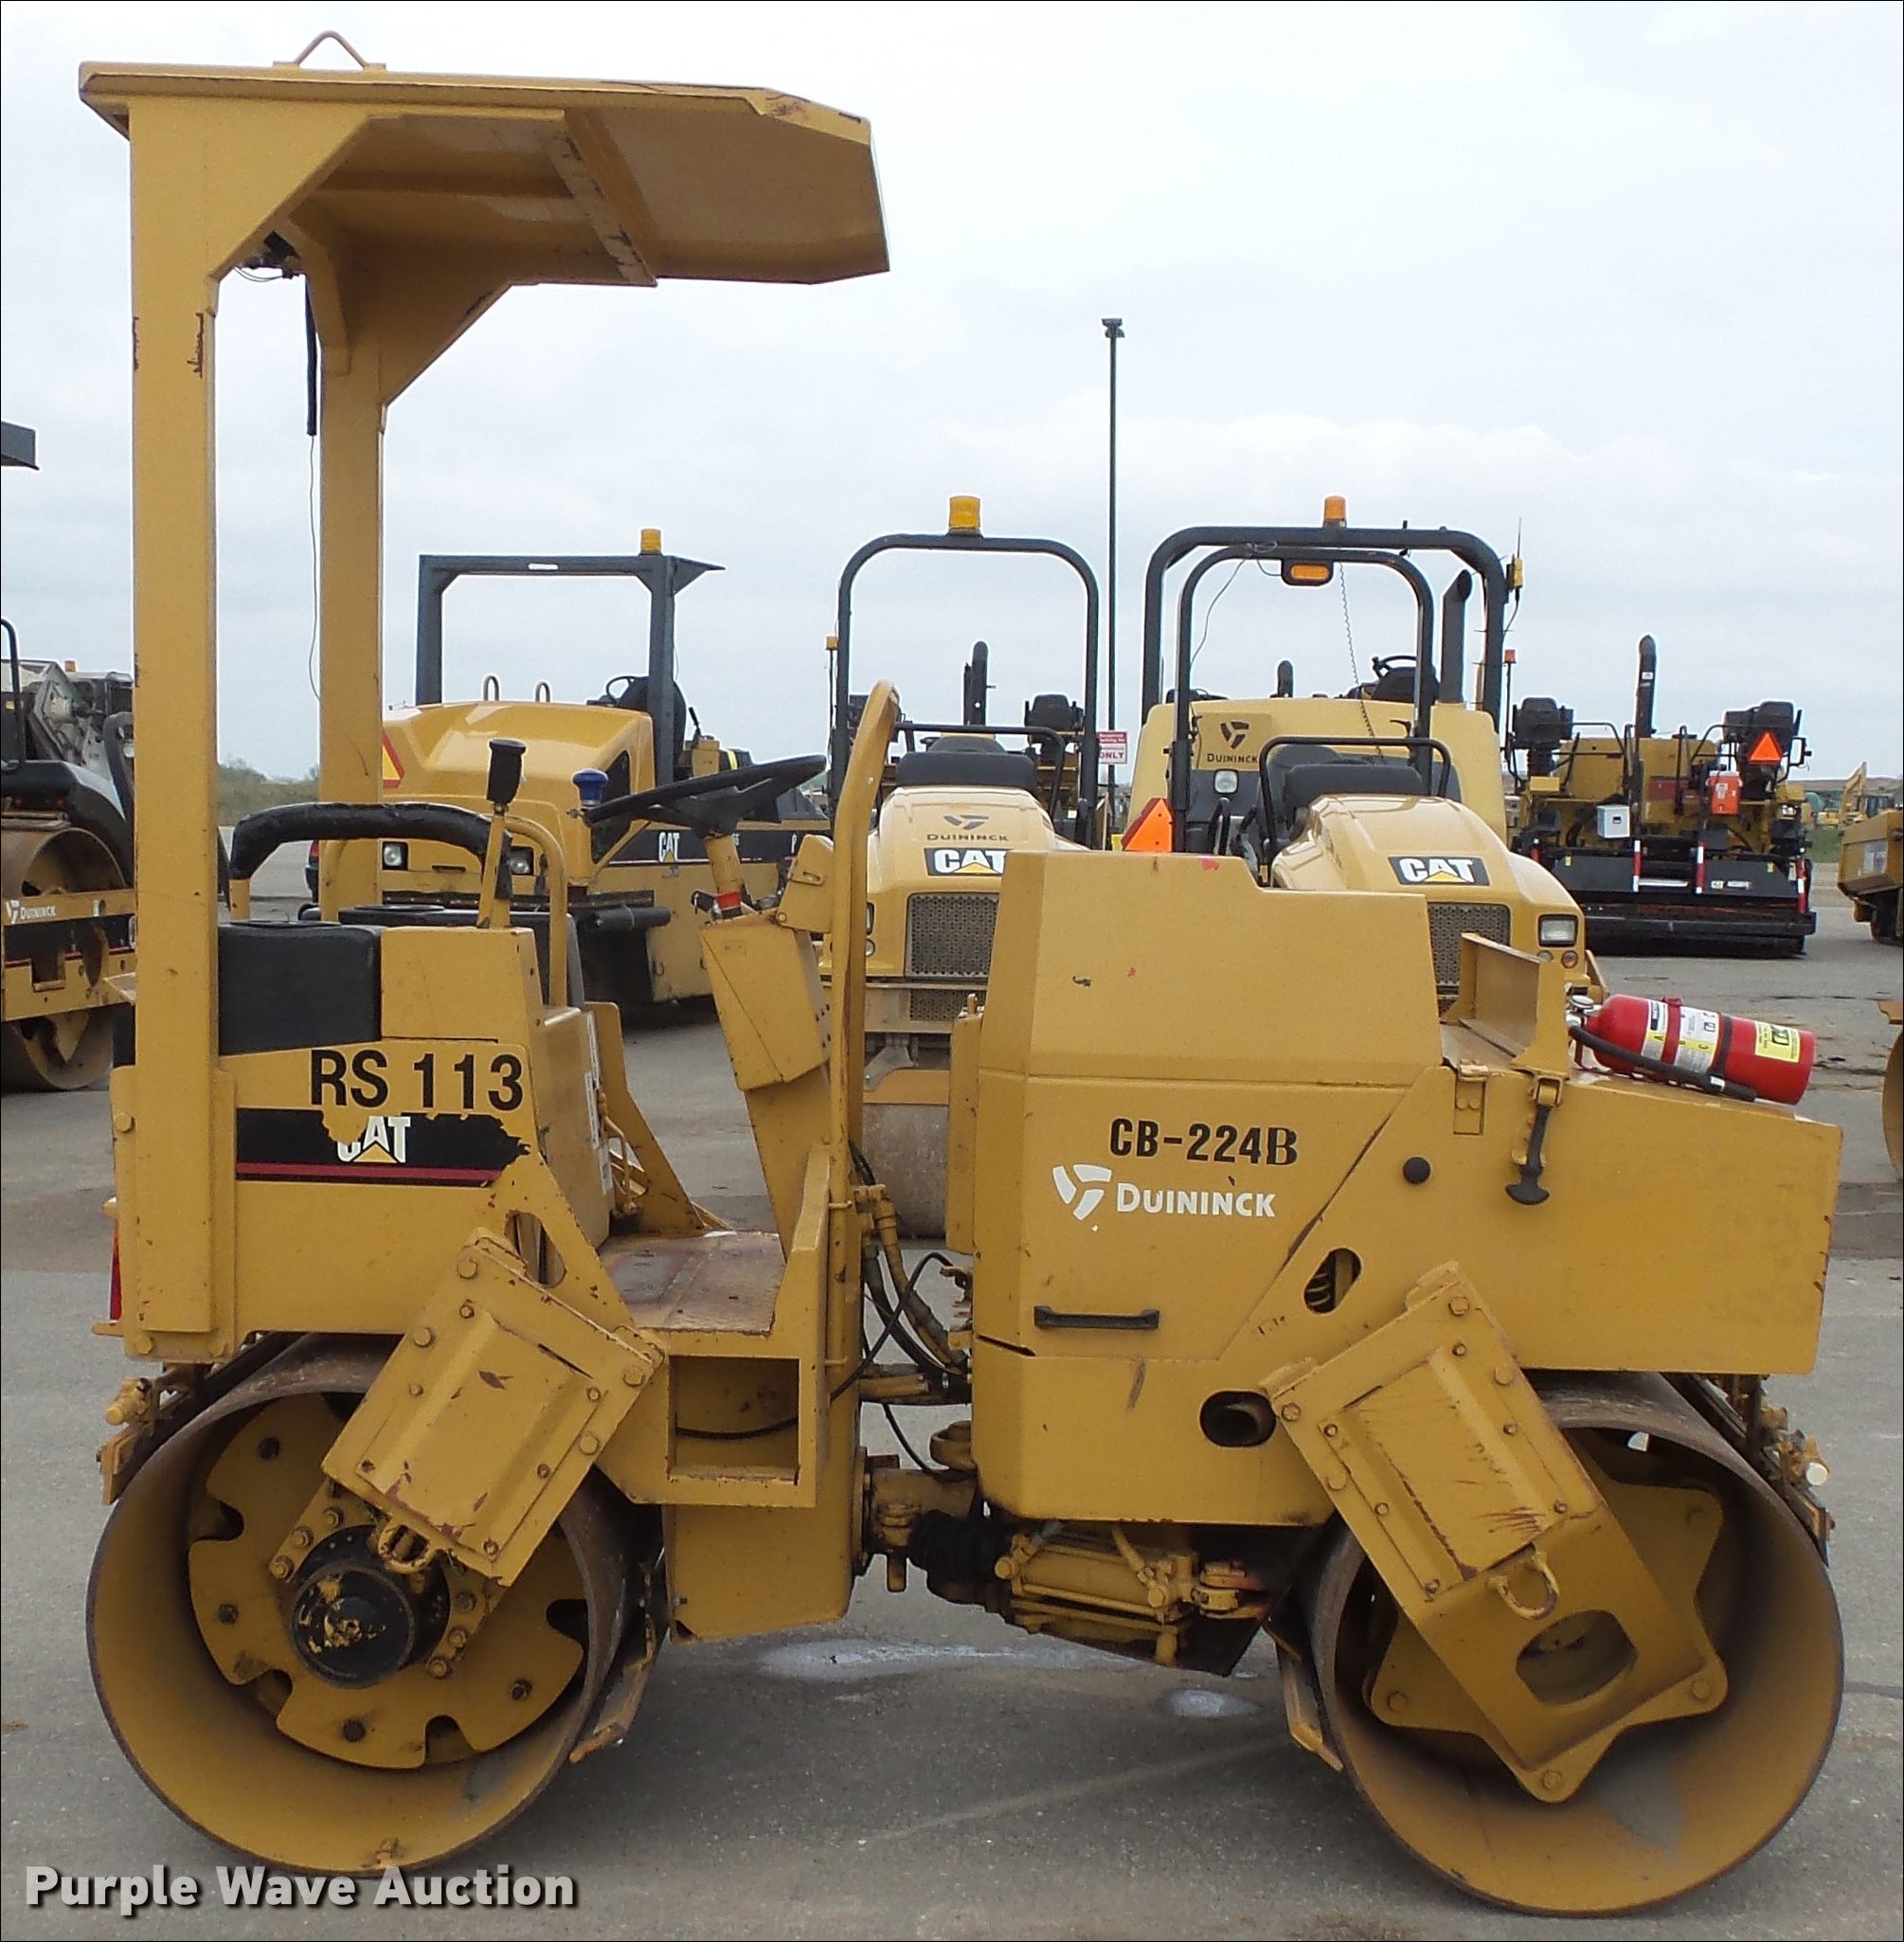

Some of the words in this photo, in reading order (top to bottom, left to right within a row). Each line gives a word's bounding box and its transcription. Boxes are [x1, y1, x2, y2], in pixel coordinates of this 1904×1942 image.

[1207, 753, 1258, 764] DUININCK
[658, 832, 680, 863] CAT
[934, 849, 1007, 874] CAT
[1399, 857, 1475, 883] CAT
[311, 1049, 388, 1108] RS
[413, 1053, 523, 1111] 113
[1109, 1117, 1298, 1166] CB-224B
[1116, 1182, 1276, 1217] DUININCK
